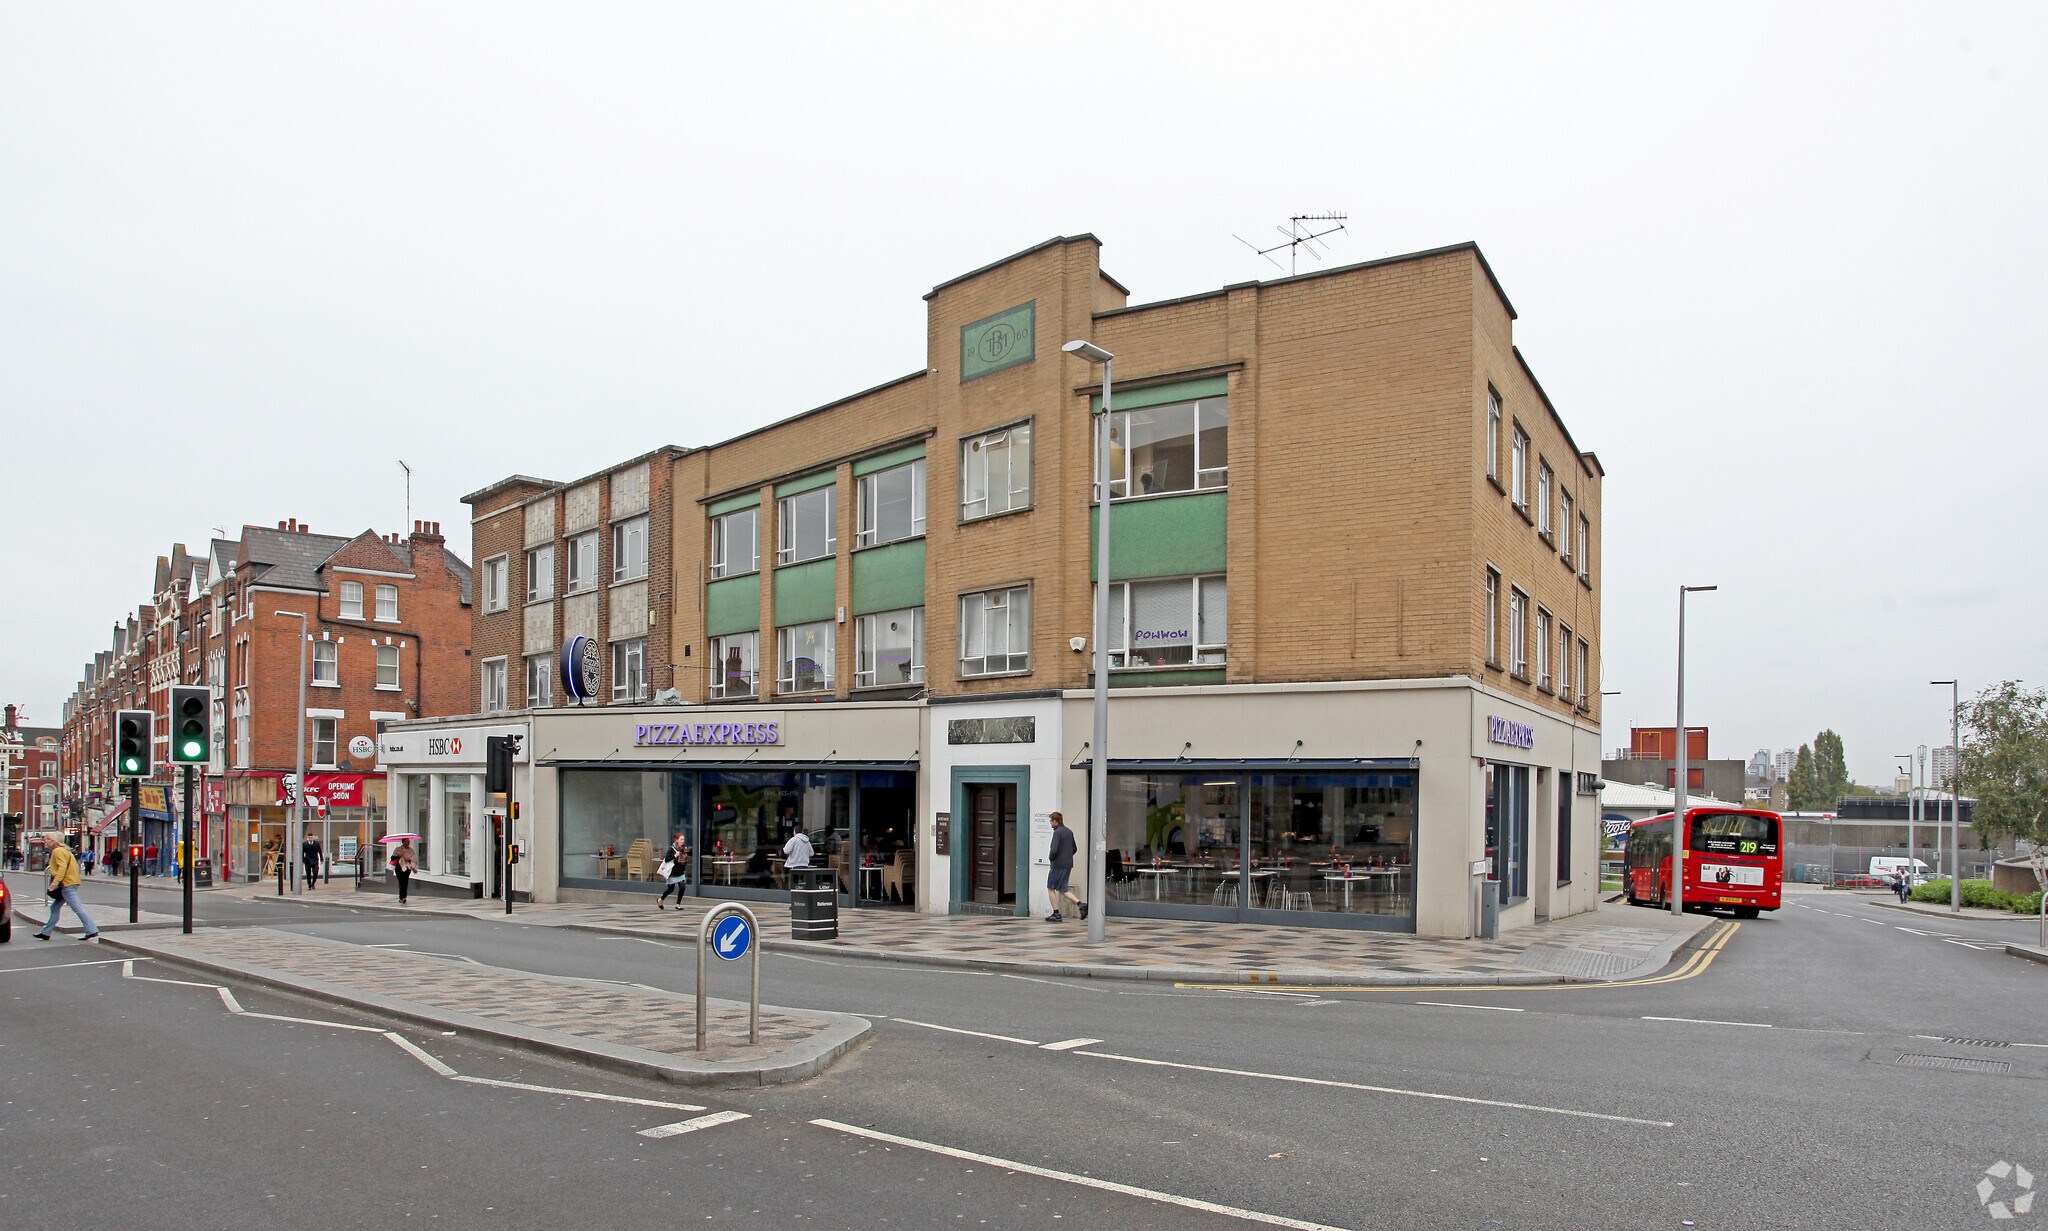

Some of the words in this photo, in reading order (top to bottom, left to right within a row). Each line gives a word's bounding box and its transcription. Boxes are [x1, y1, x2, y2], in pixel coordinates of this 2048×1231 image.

[1016, 328, 1029, 341] 60
[636, 722, 778, 745] PIZZAEXPRESS
[1490, 715, 1534, 750] PIZZAEXPRESS
[429, 738, 450, 755] HSBC
[328, 782, 355, 791] OPENING
[332, 792, 350, 800] SOON
[1740, 841, 1757, 853] 219
